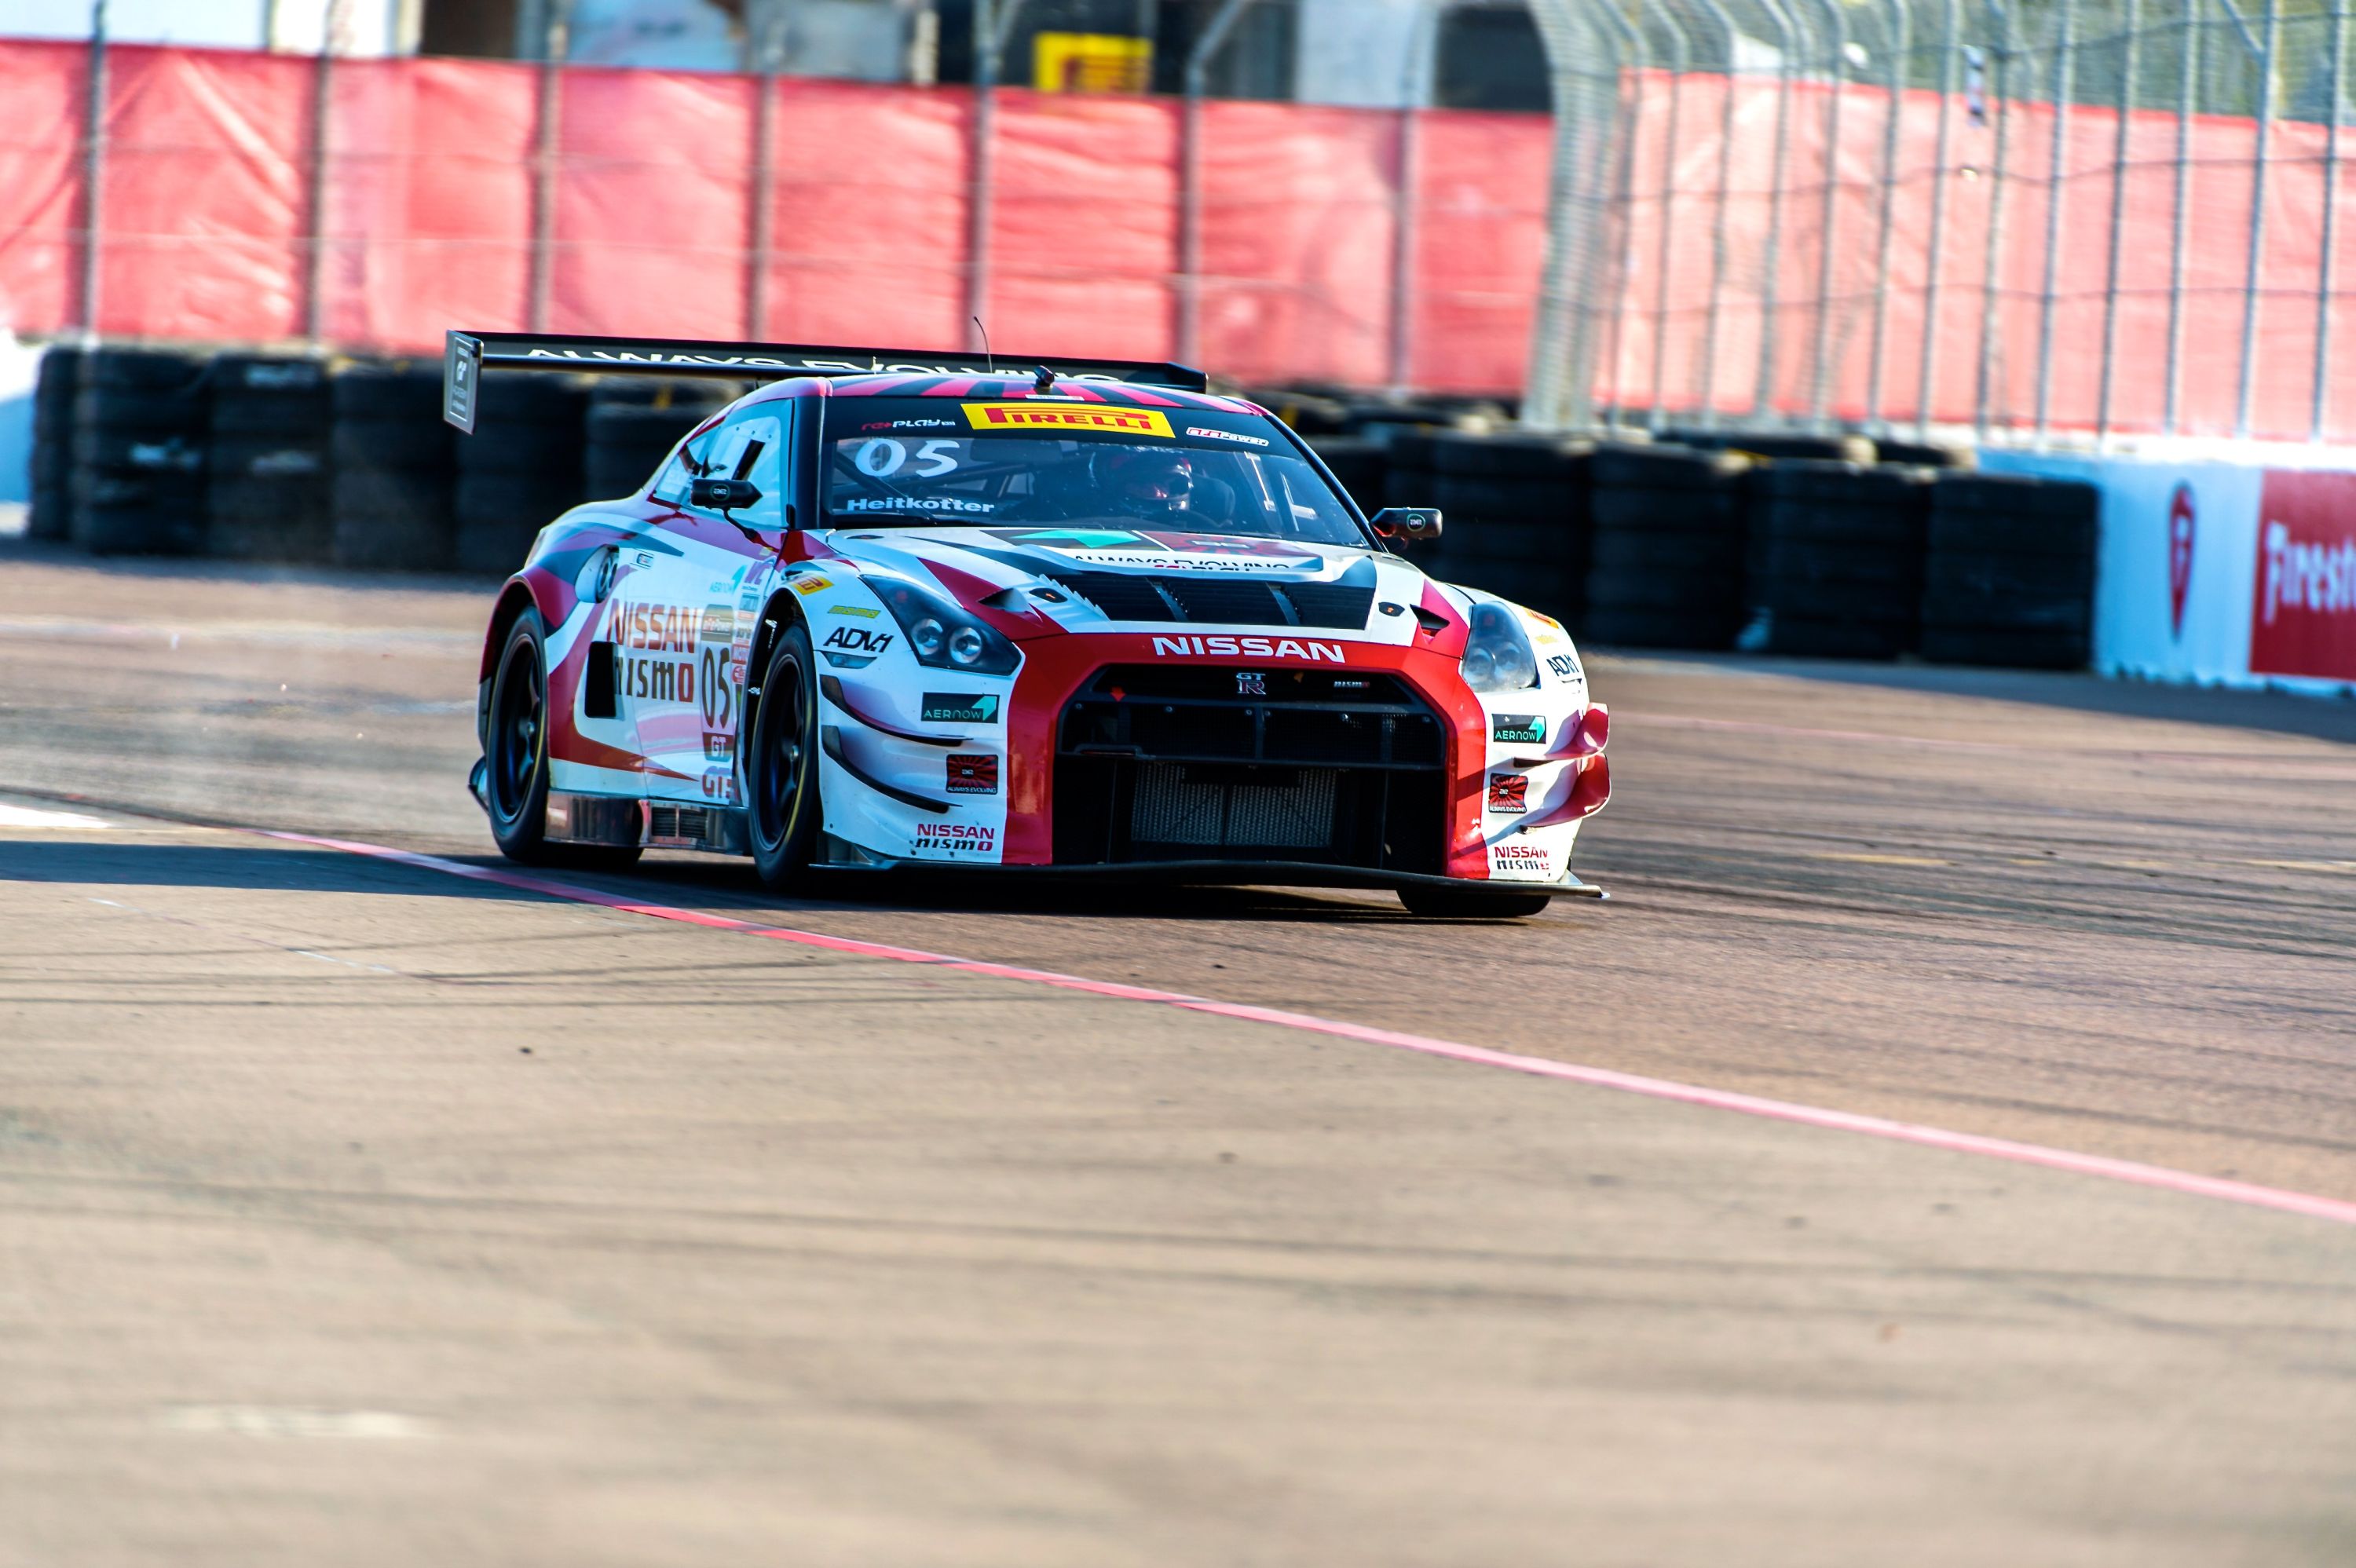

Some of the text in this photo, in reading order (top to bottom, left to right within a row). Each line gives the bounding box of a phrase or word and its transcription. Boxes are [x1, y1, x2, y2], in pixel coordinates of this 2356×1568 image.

[983, 408, 1153, 430] PIRELLI
[855, 438, 960, 477] 05
[847, 497, 995, 513] Heitkotter
[606, 598, 698, 653] NISSAN
[1152, 637, 1346, 663] NISSAN
[701, 646, 730, 729] 05
[1236, 672, 1267, 681] GT
[917, 823, 995, 839] NISSAN
[1494, 846, 1548, 858] NISSAN
